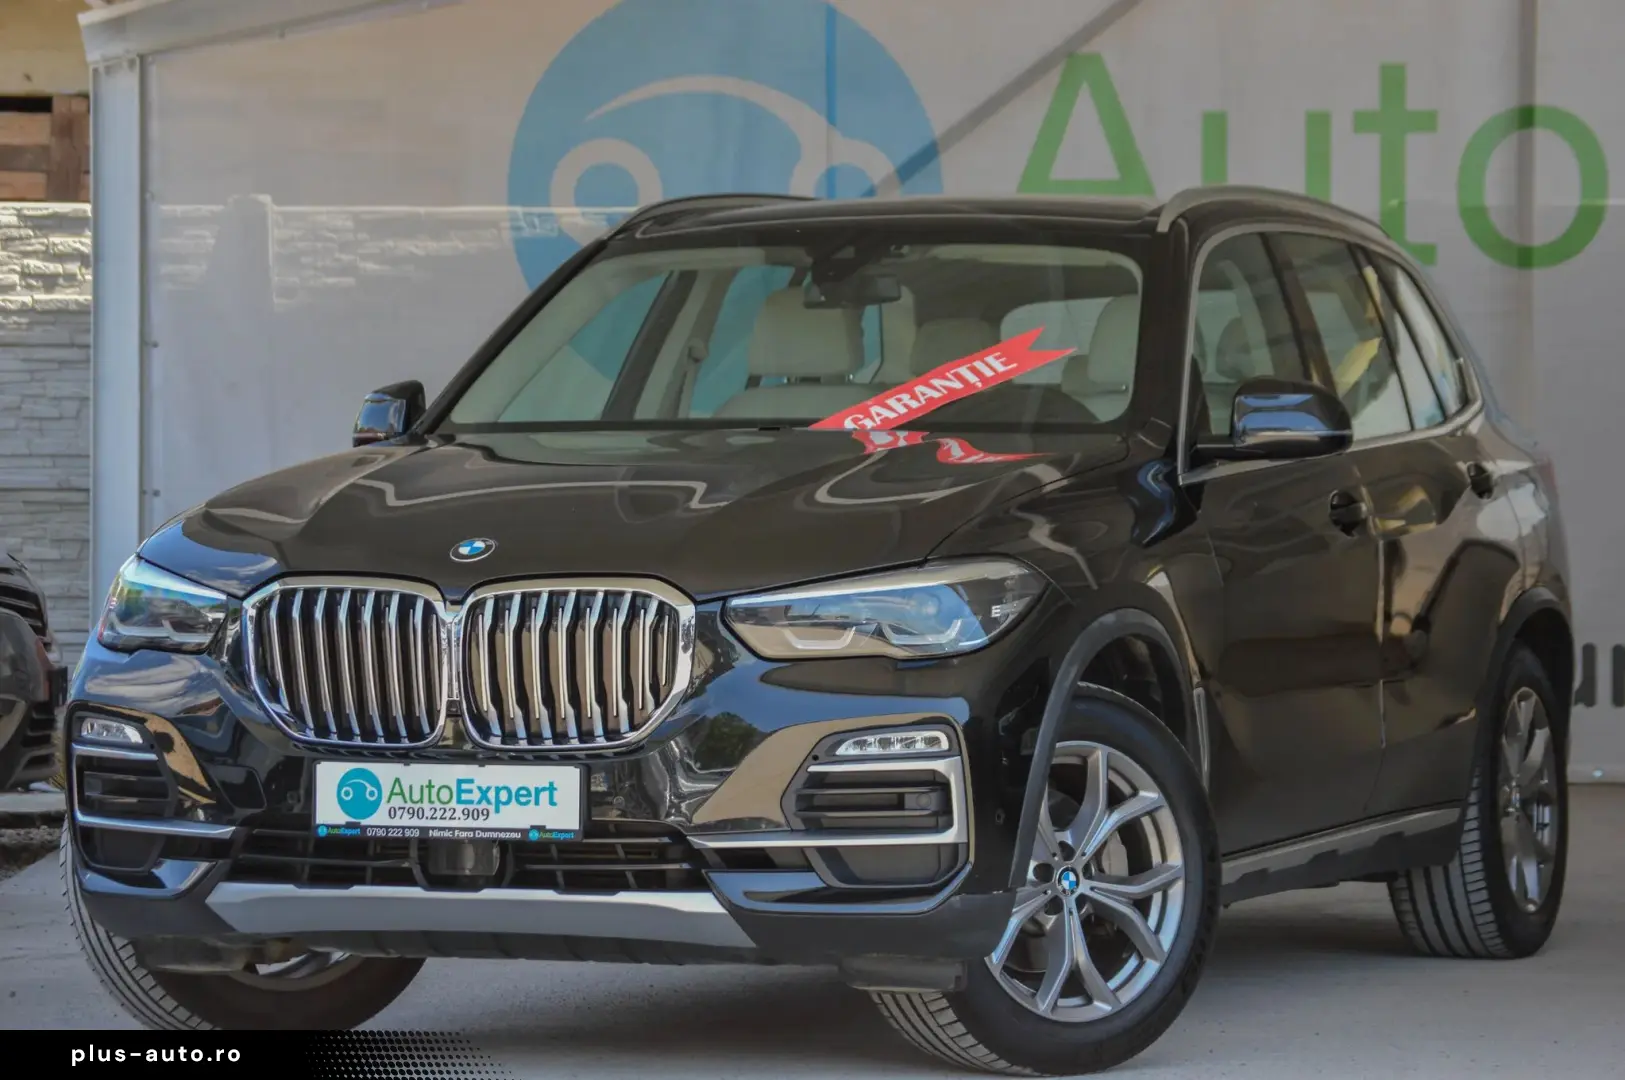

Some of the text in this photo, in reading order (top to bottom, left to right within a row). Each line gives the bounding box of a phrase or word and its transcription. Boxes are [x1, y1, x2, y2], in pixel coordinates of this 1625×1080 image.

[387, 777, 558, 813] AutoExpert
[388, 806, 491, 821] 0790.222.909
[366, 828, 386, 837] 0790
[387, 828, 404, 837] 222
[404, 828, 420, 837] 909
[428, 829, 453, 838] Nimic
[475, 830, 521, 839] Dumnezeu
